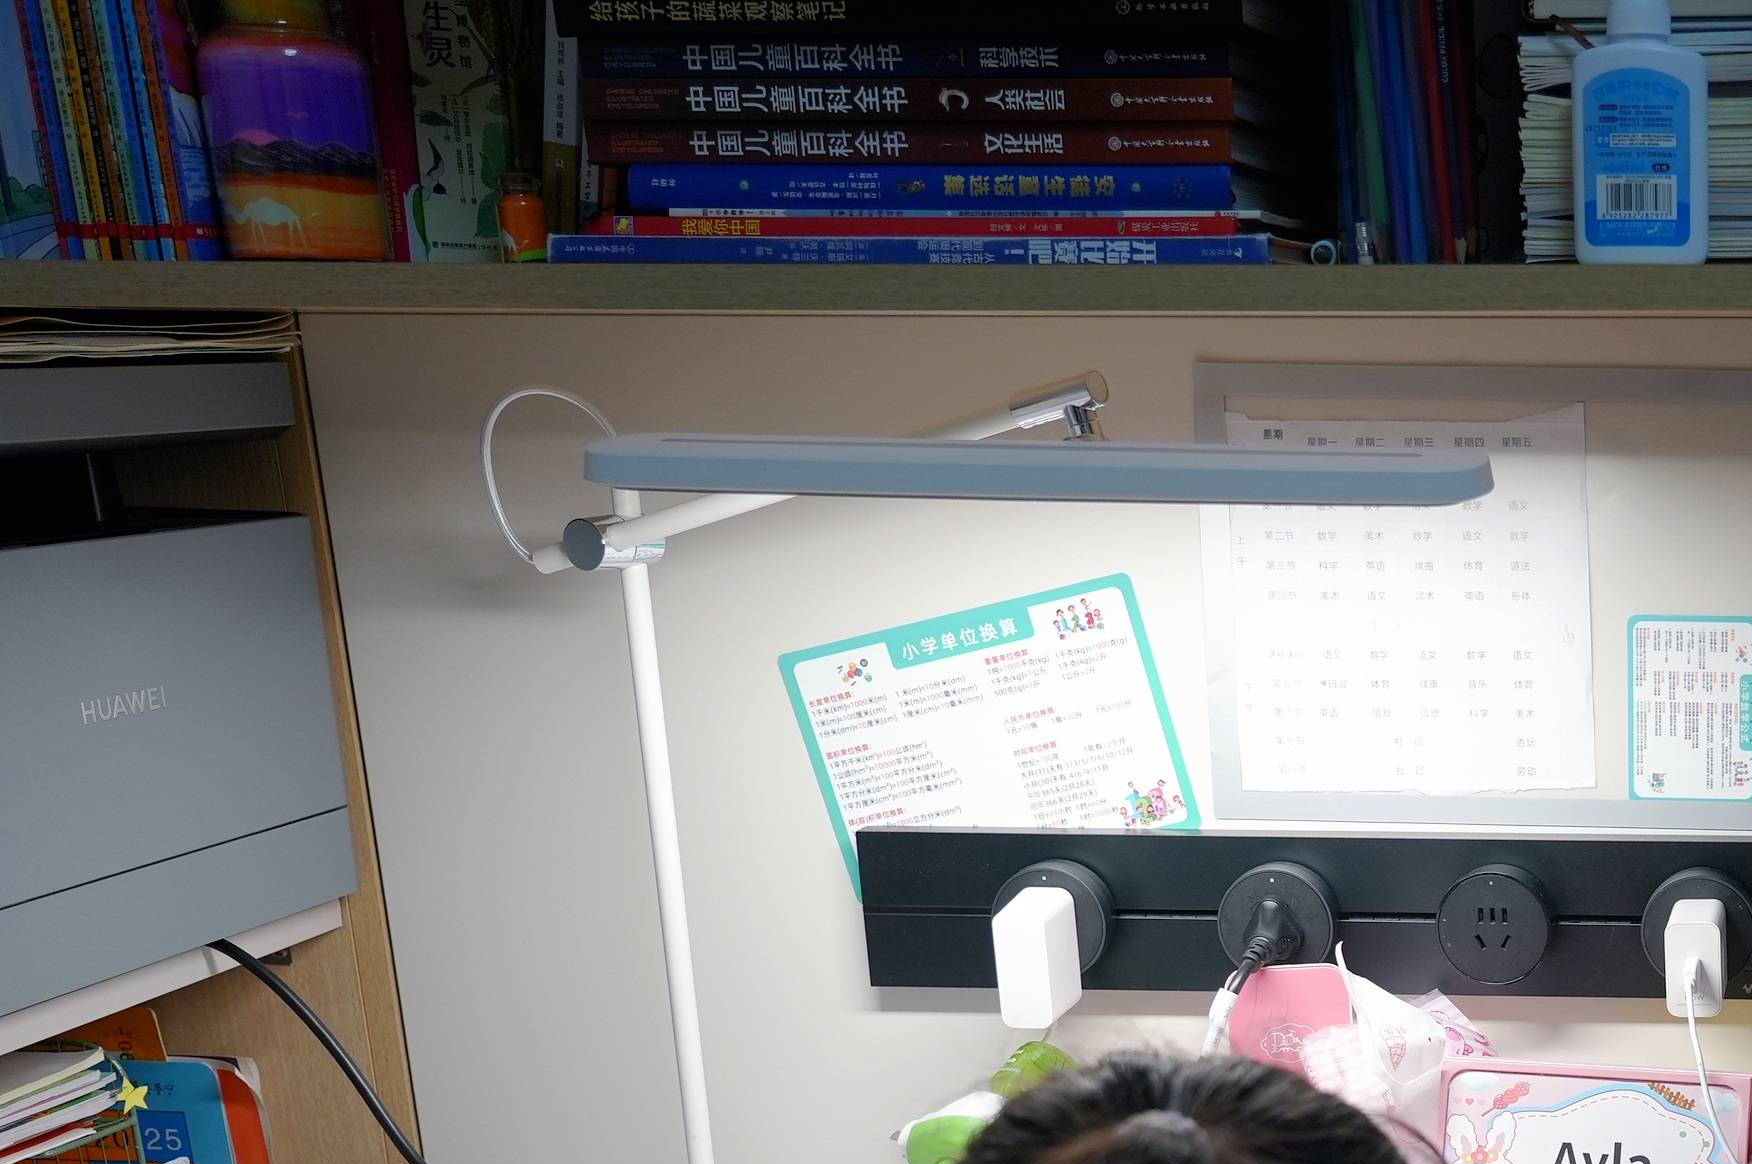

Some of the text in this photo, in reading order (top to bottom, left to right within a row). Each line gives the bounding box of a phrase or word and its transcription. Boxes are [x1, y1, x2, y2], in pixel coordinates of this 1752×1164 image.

[589, 0, 848, 22] 给孩子的蔬菜观察笔记
[422, 0, 456, 68] 生灵
[682, 43, 905, 72] 中国儿童百科全书
[978, 44, 1062, 69] 科学技术
[685, 85, 909, 113] 中国儿童百科全书
[984, 88, 1066, 112] 人类社会
[689, 130, 911, 157] 中国儿童百科全书
[983, 131, 1065, 156] 文化生活
[651, 177, 678, 188] 外研社
[944, 175, 1117, 197] 安徒生童话选集
[681, 218, 763, 236] 我爱你中国
[1263, 428, 1284, 440] 星期
[1307, 436, 1533, 449] 星期一 星期二 星期三 星期四 星期五
[1508, 499, 1529, 511] 语文
[1263, 530, 1529, 543] 第二节 数学 美术 数学 语文 数学
[1265, 560, 1531, 573] 第三节 科学 英语 戏曲 体育 道法
[1267, 590, 1297, 602] 第四节
[1319, 590, 1340, 602] 美术
[1367, 590, 1388, 602] 语文
[1463, 590, 1485, 602] 英语
[1510, 590, 1532, 602] 形体
[901, 616, 1020, 661] 小学单位换算
[1322, 649, 1534, 661] 语文 数学 语文 数学 语文
[1370, 679, 1391, 690] 体育
[1468, 679, 1488, 690] 音乐
[1513, 679, 1534, 690] 体育
[80, 685, 168, 727] HUAWEI
[808, 690, 856, 708] 长度单位换算:
[811, 694, 888, 718] 1千米(km)=1000米(m)
[898, 683, 979, 709] 1米(m)=1000毫米(mm)
[902, 693, 985, 720] 1厘米(cm)=10毫米(mm)
[815, 705, 887, 729] 1米(m)=100厘米(cm)
[1318, 708, 1339, 719] 英语
[1371, 708, 1393, 719] 信息
[1419, 708, 1440, 719] 信息
[1468, 708, 1489, 719] 科学
[1513, 708, 1535, 720] 美术
[1739, 680, 1751, 744] 小学数学公式
[818, 713, 898, 739] 1分米(dm)=10厘米(cm)
[825, 742, 873, 761] 面积单位换算:
[1516, 766, 1537, 777] 劳动
[847, 806, 908, 828] 体(容)积单位换算:
[143, 1127, 183, 1152] 25
